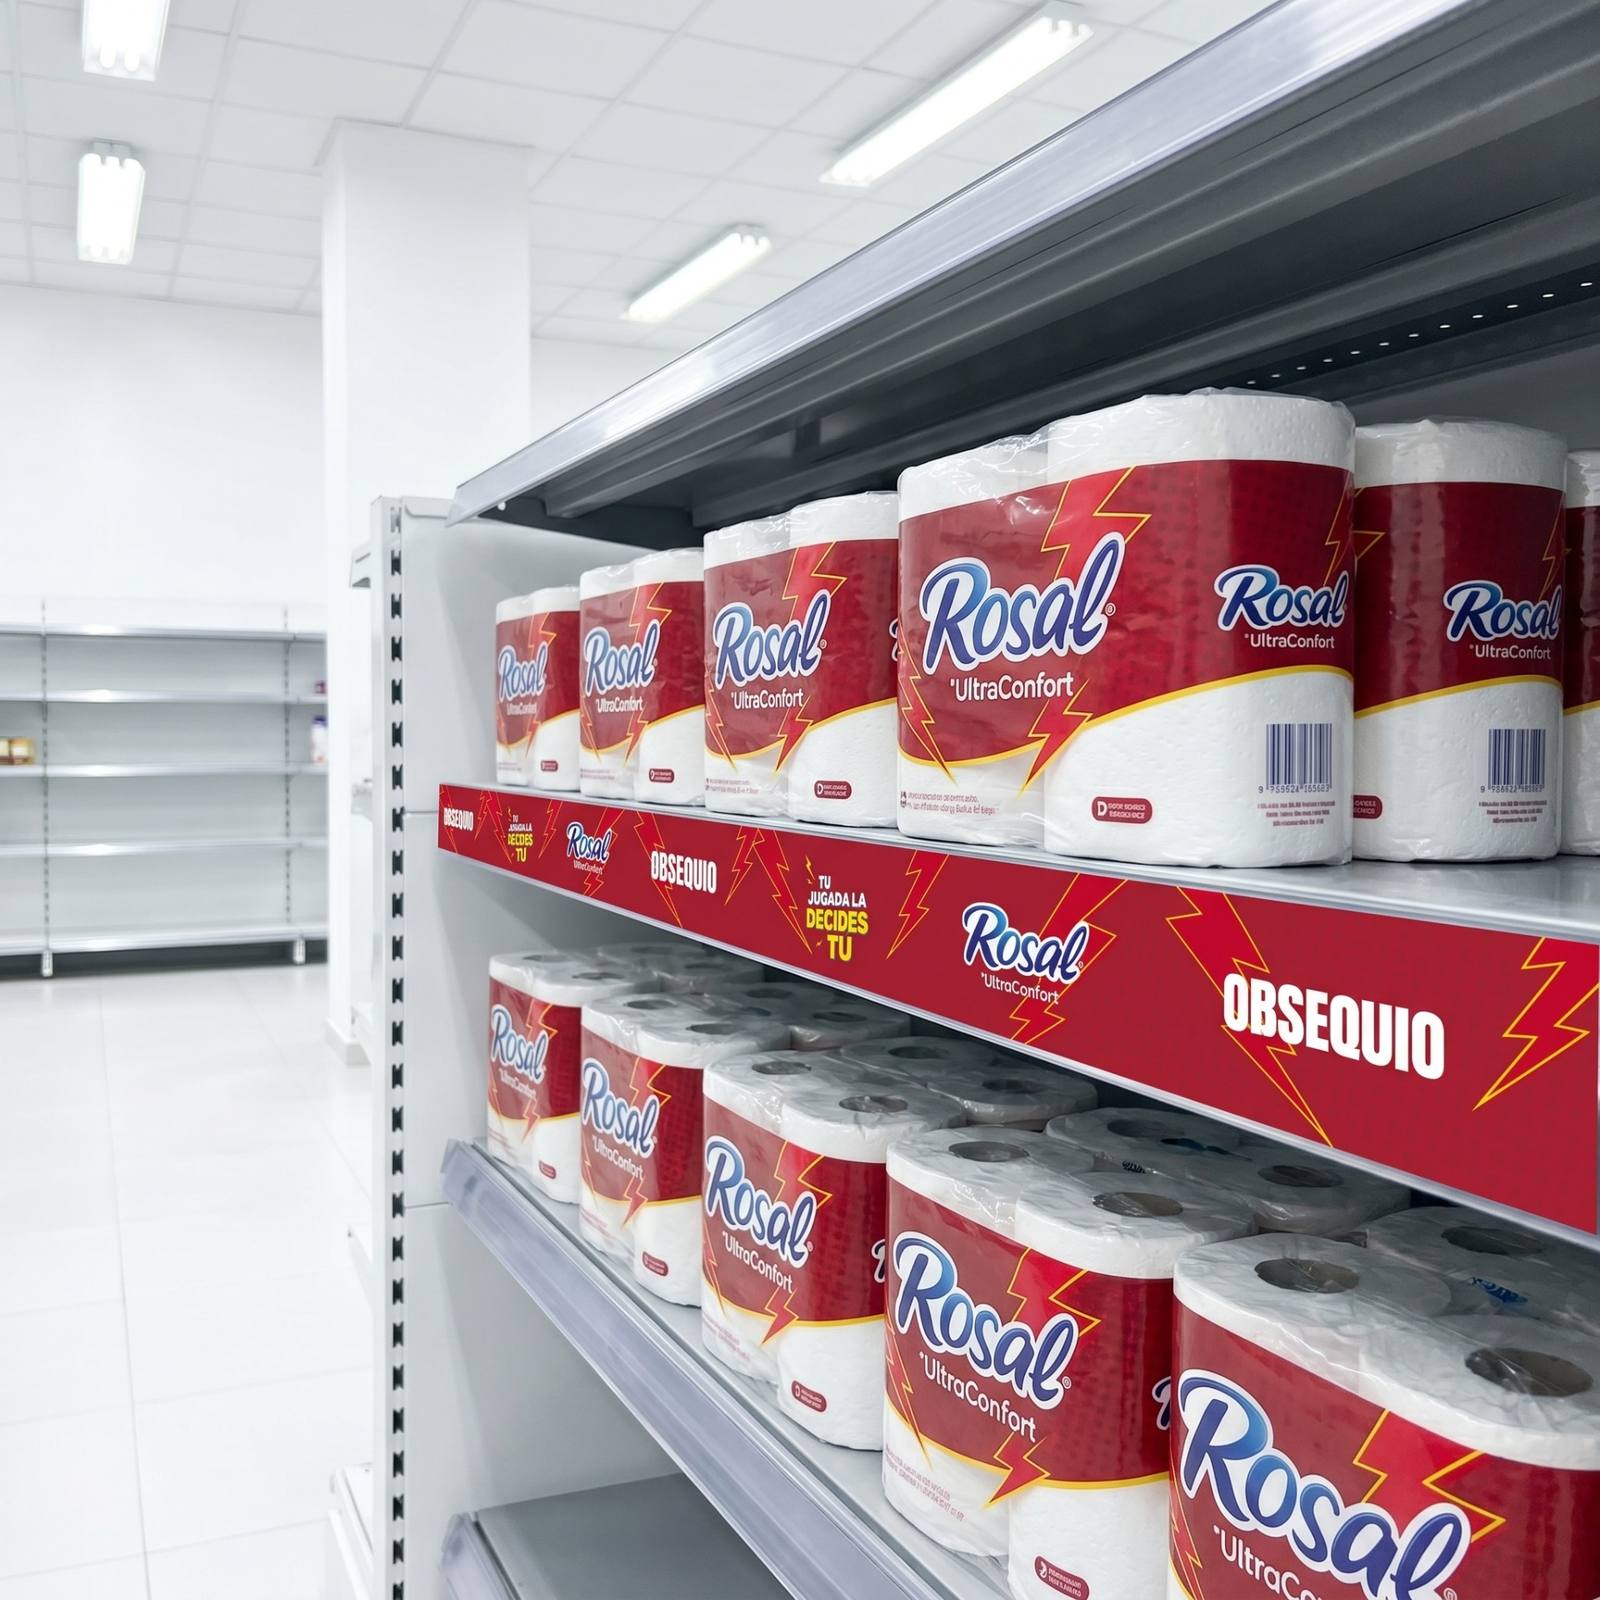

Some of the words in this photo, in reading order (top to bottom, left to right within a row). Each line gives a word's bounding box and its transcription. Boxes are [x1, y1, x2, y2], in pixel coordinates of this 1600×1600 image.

[920, 531, 1125, 675] Rosal
[1214, 564, 1349, 631] Rosal
[1444, 580, 1562, 642] Rosal
[584, 619, 660, 696] Rosal
[713, 588, 831, 688] Rosal
[1244, 633, 1335, 650] UltraConfort
[1469, 644, 1551, 660] UltraConfort
[498, 641, 548, 702] Rosal
[731, 687, 804, 710] UltraConfort
[950, 671, 1074, 702] UltraConfort
[516, 847, 527, 862] TU
[567, 821, 613, 863] Rosal
[651, 850, 717, 894] OBSEQUIO
[808, 892, 850, 907] JUGADA
[851, 894, 866, 908] LA
[818, 875, 831, 889] TU
[806, 908, 869, 935] DECIDES
[827, 935, 852, 961] TU
[962, 901, 1090, 985] Rosal
[981, 972, 1059, 1005] UltraConfort
[490, 1004, 548, 1084] Rosal
[1223, 973, 1445, 1080] OBSEQUIO
[582, 1057, 660, 1158] Rosal
[704, 1135, 818, 1268] Rosal
[722, 1231, 793, 1294] UltraConfort
[893, 1231, 1079, 1410] Rosal
[919, 1350, 1037, 1443] UltraConfort
[1178, 1369, 1471, 1600] Rosal
